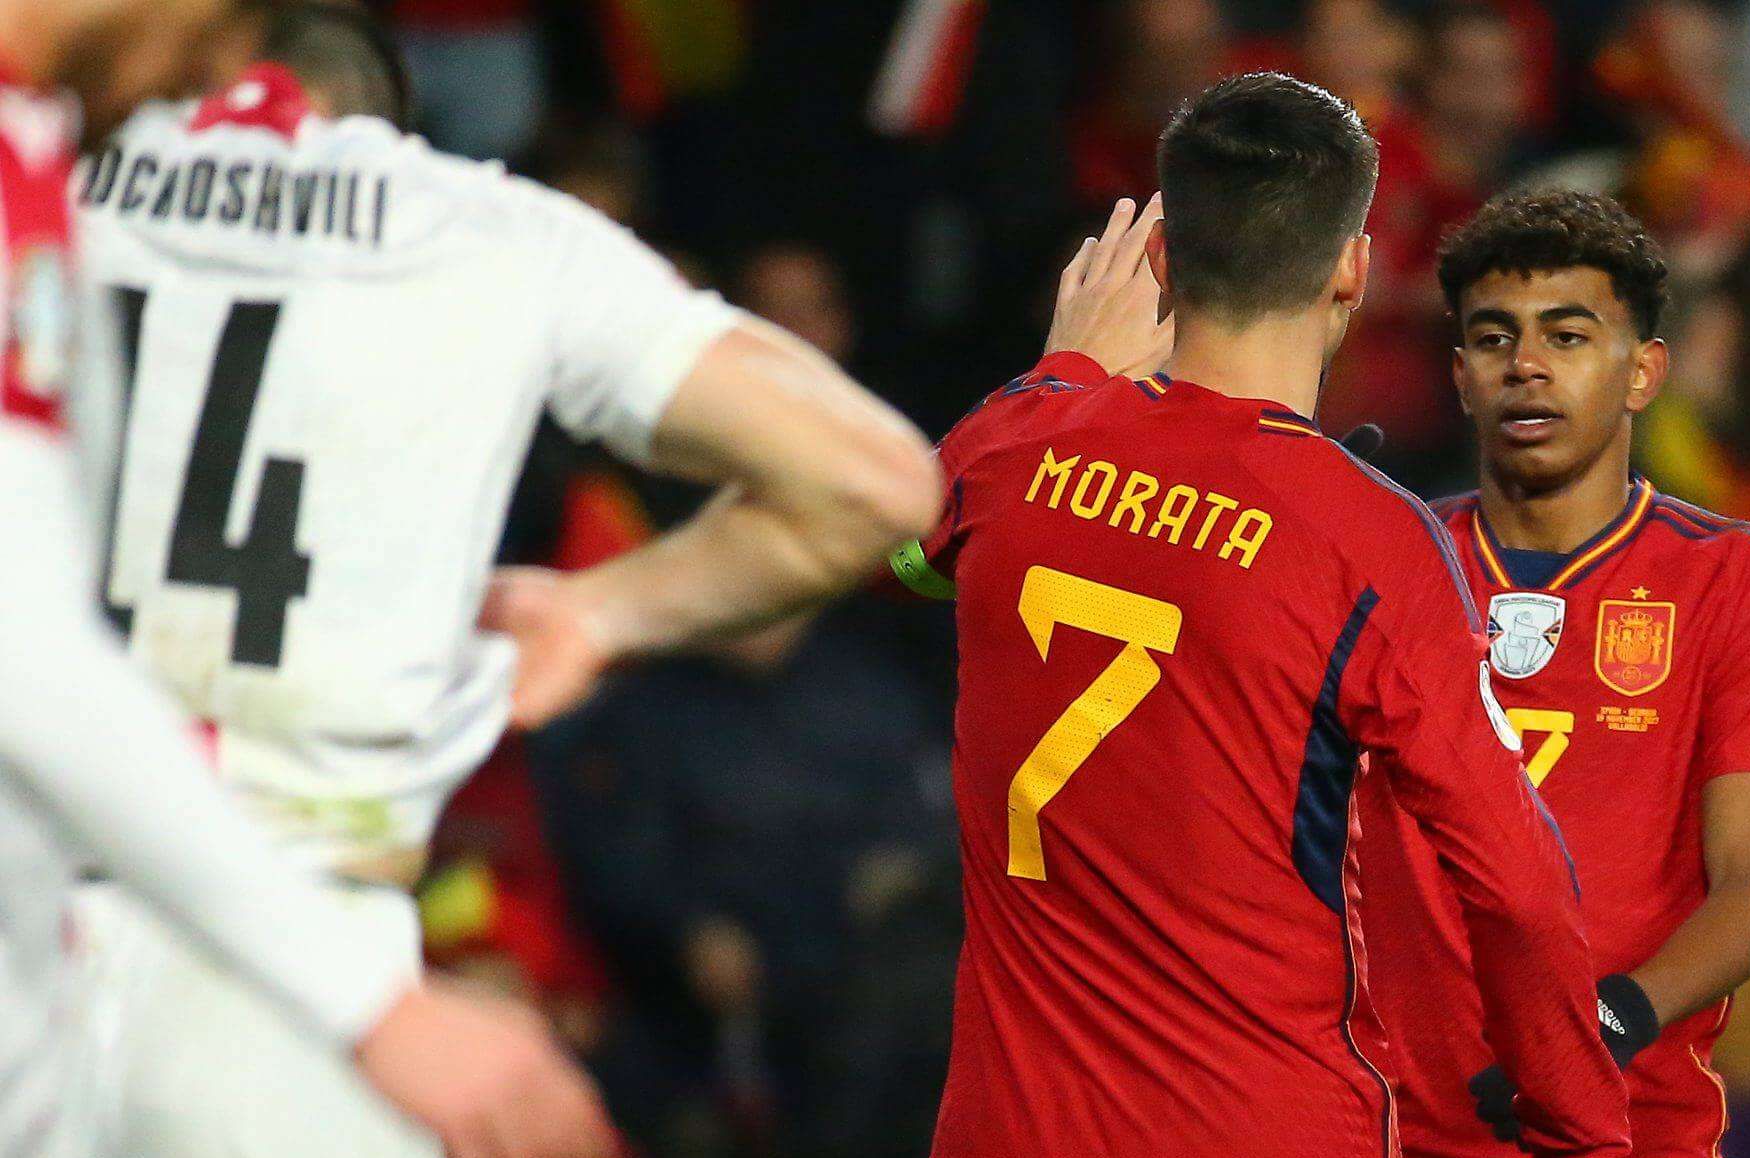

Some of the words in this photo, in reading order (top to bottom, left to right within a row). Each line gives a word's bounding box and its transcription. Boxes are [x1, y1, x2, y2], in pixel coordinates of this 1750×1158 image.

[1024, 446, 1274, 569] MORATA
[1006, 565, 1183, 882] 7
[1506, 707, 1575, 789] 7
